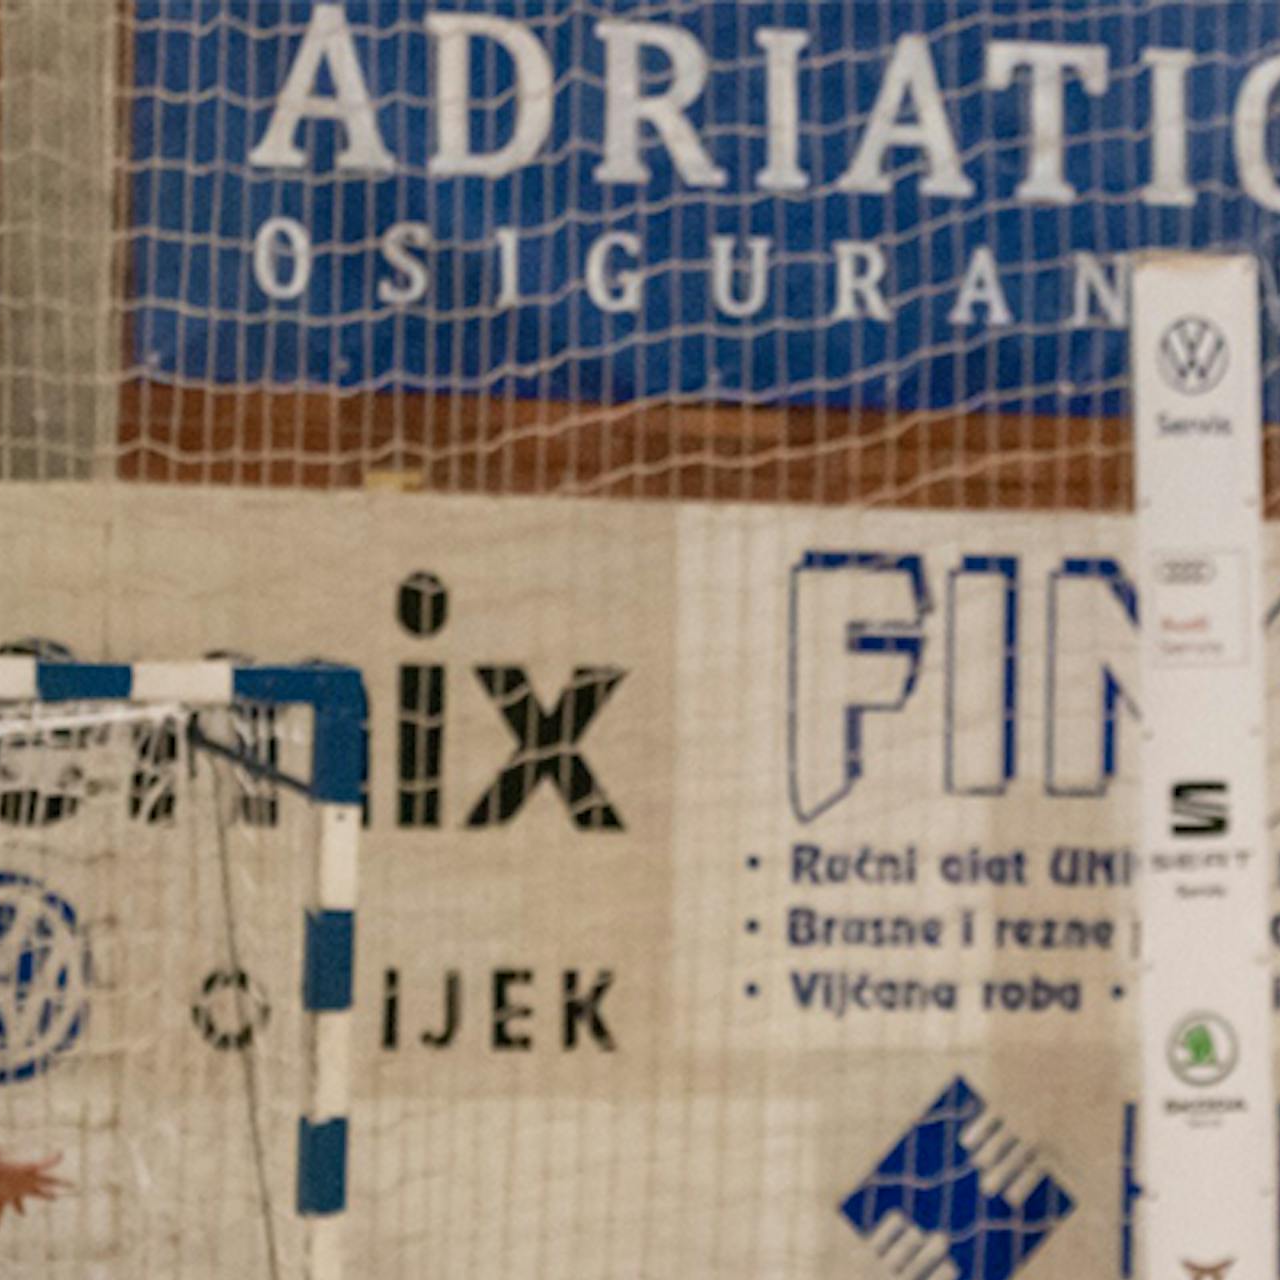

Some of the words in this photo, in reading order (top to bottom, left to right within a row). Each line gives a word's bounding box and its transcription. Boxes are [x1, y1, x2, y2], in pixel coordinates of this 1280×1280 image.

[1048, 846, 1134, 887] UNI
[191, 967, 617, 1052] OIJEK
[982, 974, 1082, 1013] roba
